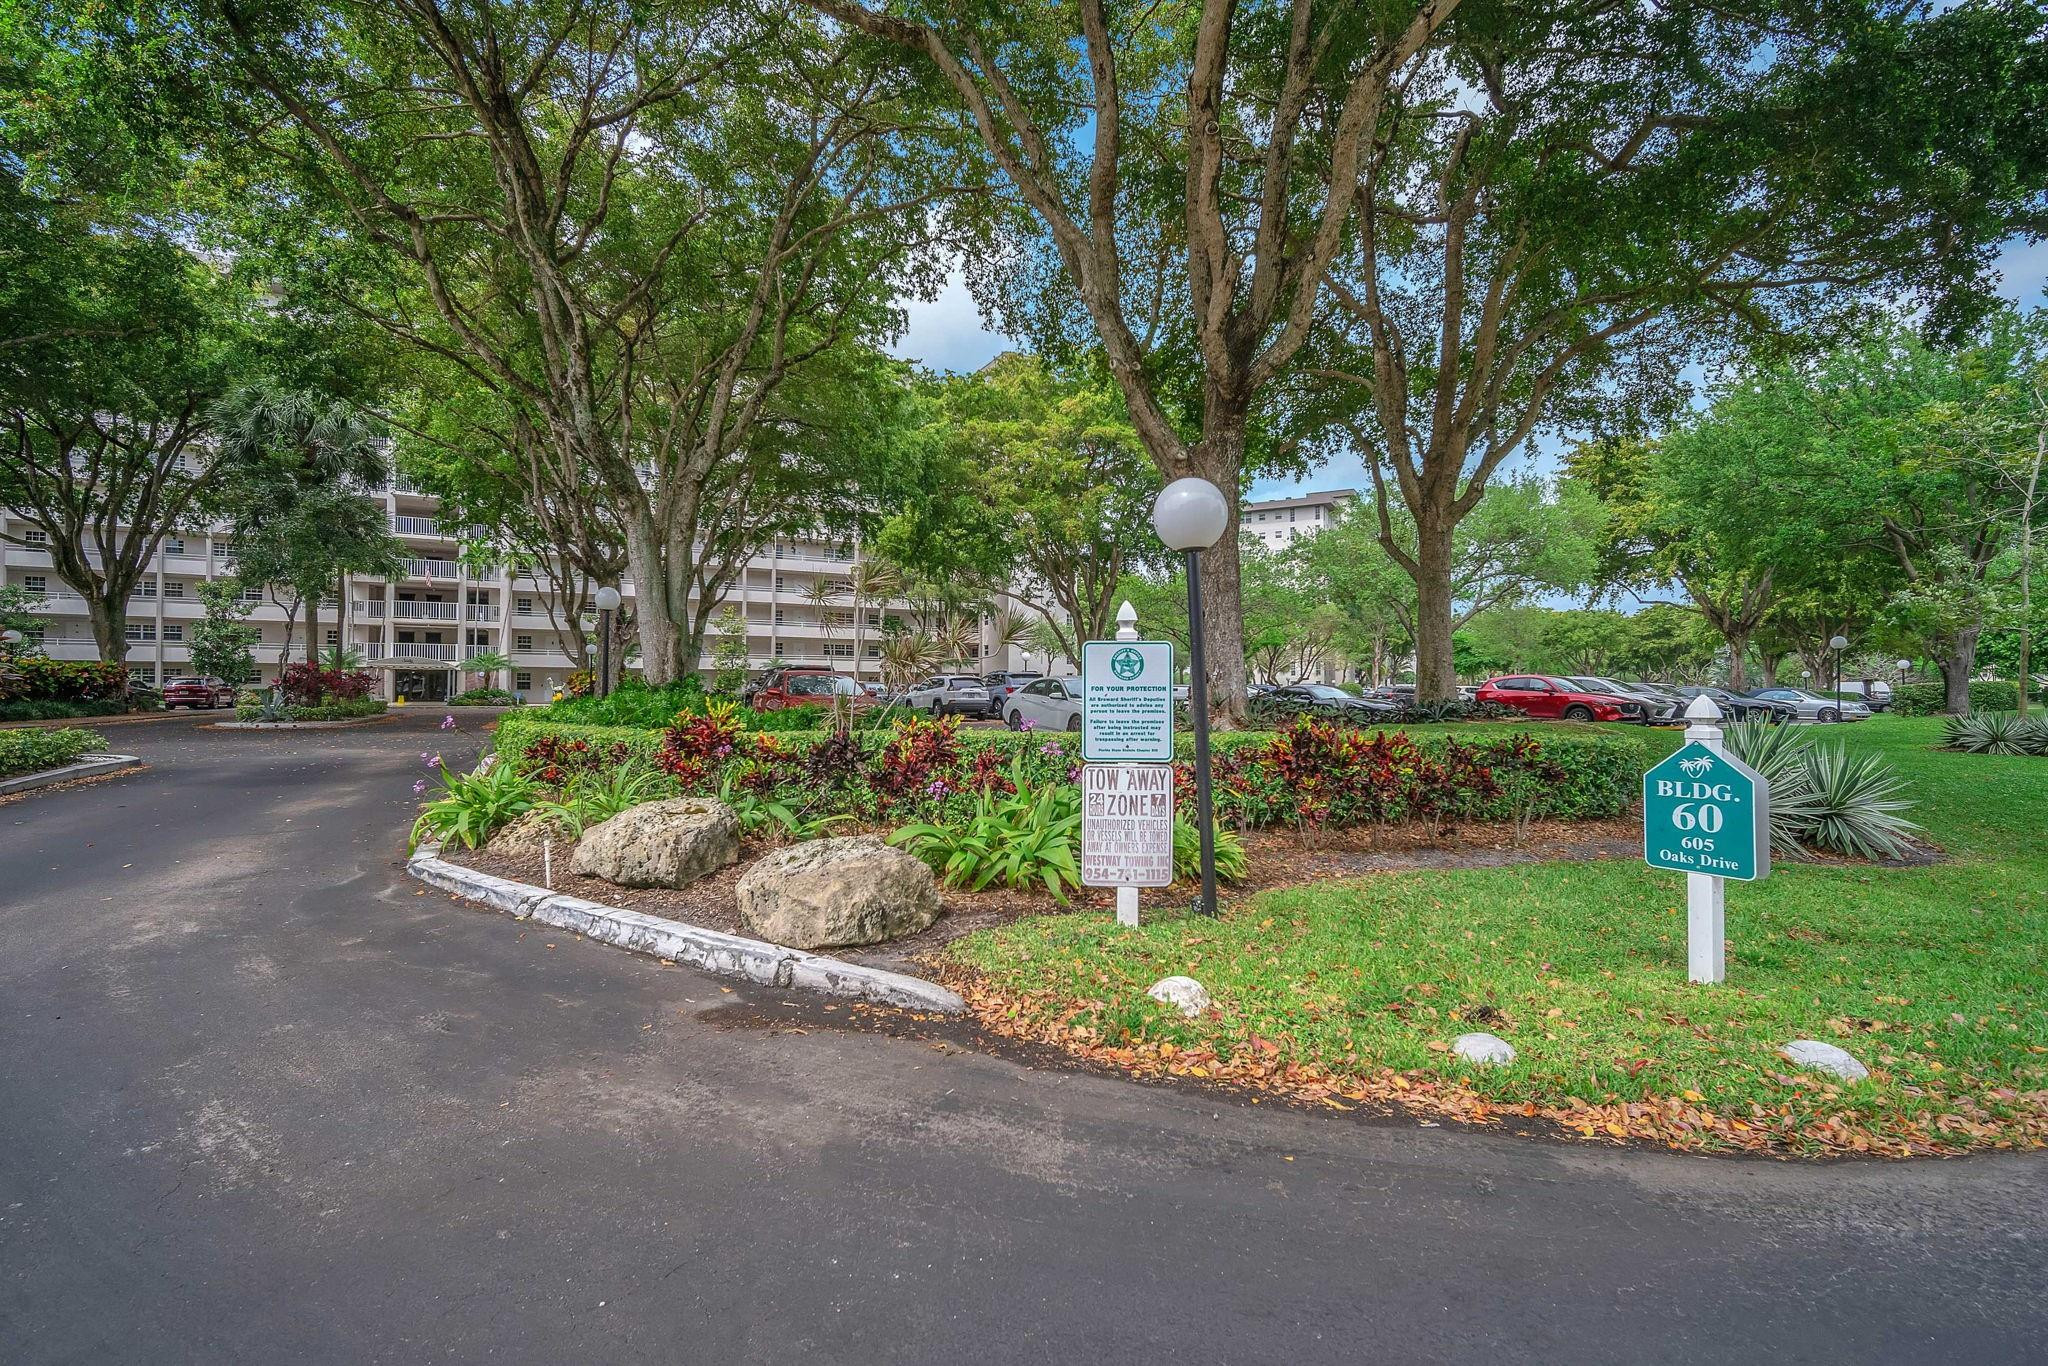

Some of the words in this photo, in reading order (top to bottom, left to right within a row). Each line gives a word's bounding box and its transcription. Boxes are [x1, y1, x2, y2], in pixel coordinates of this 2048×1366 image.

[1088, 769, 1119, 791] TOW
[1127, 769, 1167, 791] AWAY
[1656, 780, 1740, 802] BLDG.
[1090, 794, 1104, 805] 24
[1108, 794, 1148, 816] ZONE
[1155, 794, 1162, 806] 7
[1152, 805, 1166, 817] DAYS
[1672, 803, 1723, 833] 60
[1087, 819, 1136, 830] UNAUTHORIZED
[1138, 819, 1168, 830] VEHICLES
[1087, 830, 1095, 842] OR
[1097, 830, 1122, 842] VESSELS
[1124, 830, 1137, 842] WILL
[1140, 830, 1147, 842] BE
[1149, 830, 1168, 842] TOWED
[1087, 842, 1102, 853] AWAY
[1105, 842, 1112, 853] AT
[1142, 842, 1168, 853] EXPENSE
[1681, 836, 1715, 852] 605
[1086, 855, 1121, 867] WESTWAY
[1124, 855, 1154, 867] TOWING
[1157, 855, 1169, 867] INC
[1660, 849, 1695, 864] Oaks
[1700, 854, 1739, 870] Drive
